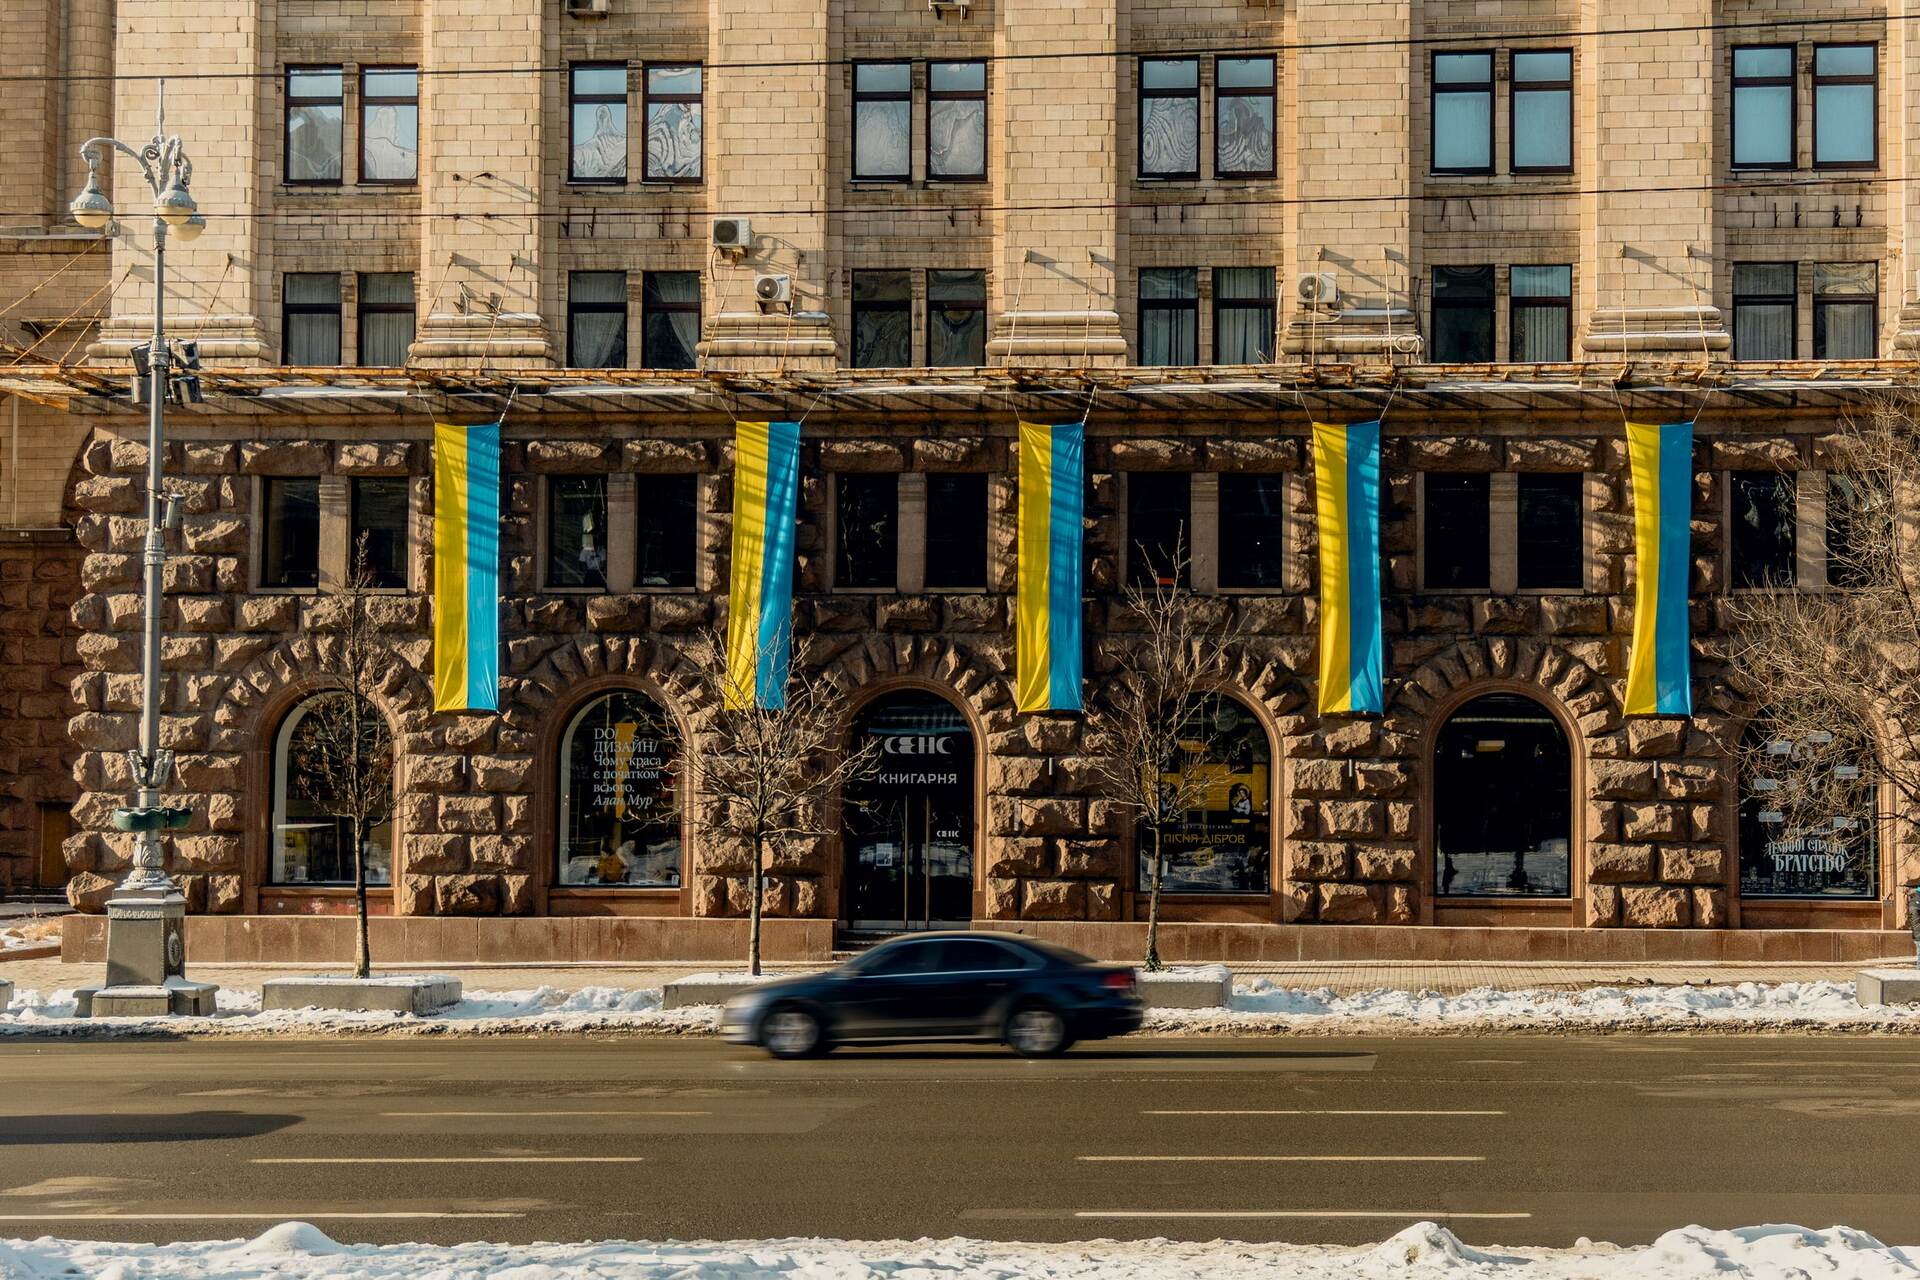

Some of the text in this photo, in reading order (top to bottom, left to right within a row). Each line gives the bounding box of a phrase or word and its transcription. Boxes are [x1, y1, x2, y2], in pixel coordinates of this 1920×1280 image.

[593, 736, 659, 754] ДИЗАЙН/
[884, 736, 952, 755] СЕНС
[594, 754, 662, 770] Чому краса
[593, 770, 659, 779] є початком
[878, 773, 957, 784] КНИГАРНЯ
[593, 783, 635, 793] всього.
[593, 794, 653, 810] Алан Мур
[1163, 833, 1246, 845] ПІСНЯ ДІБРОВ
[1771, 853, 1845, 873] БРАТСТВО
